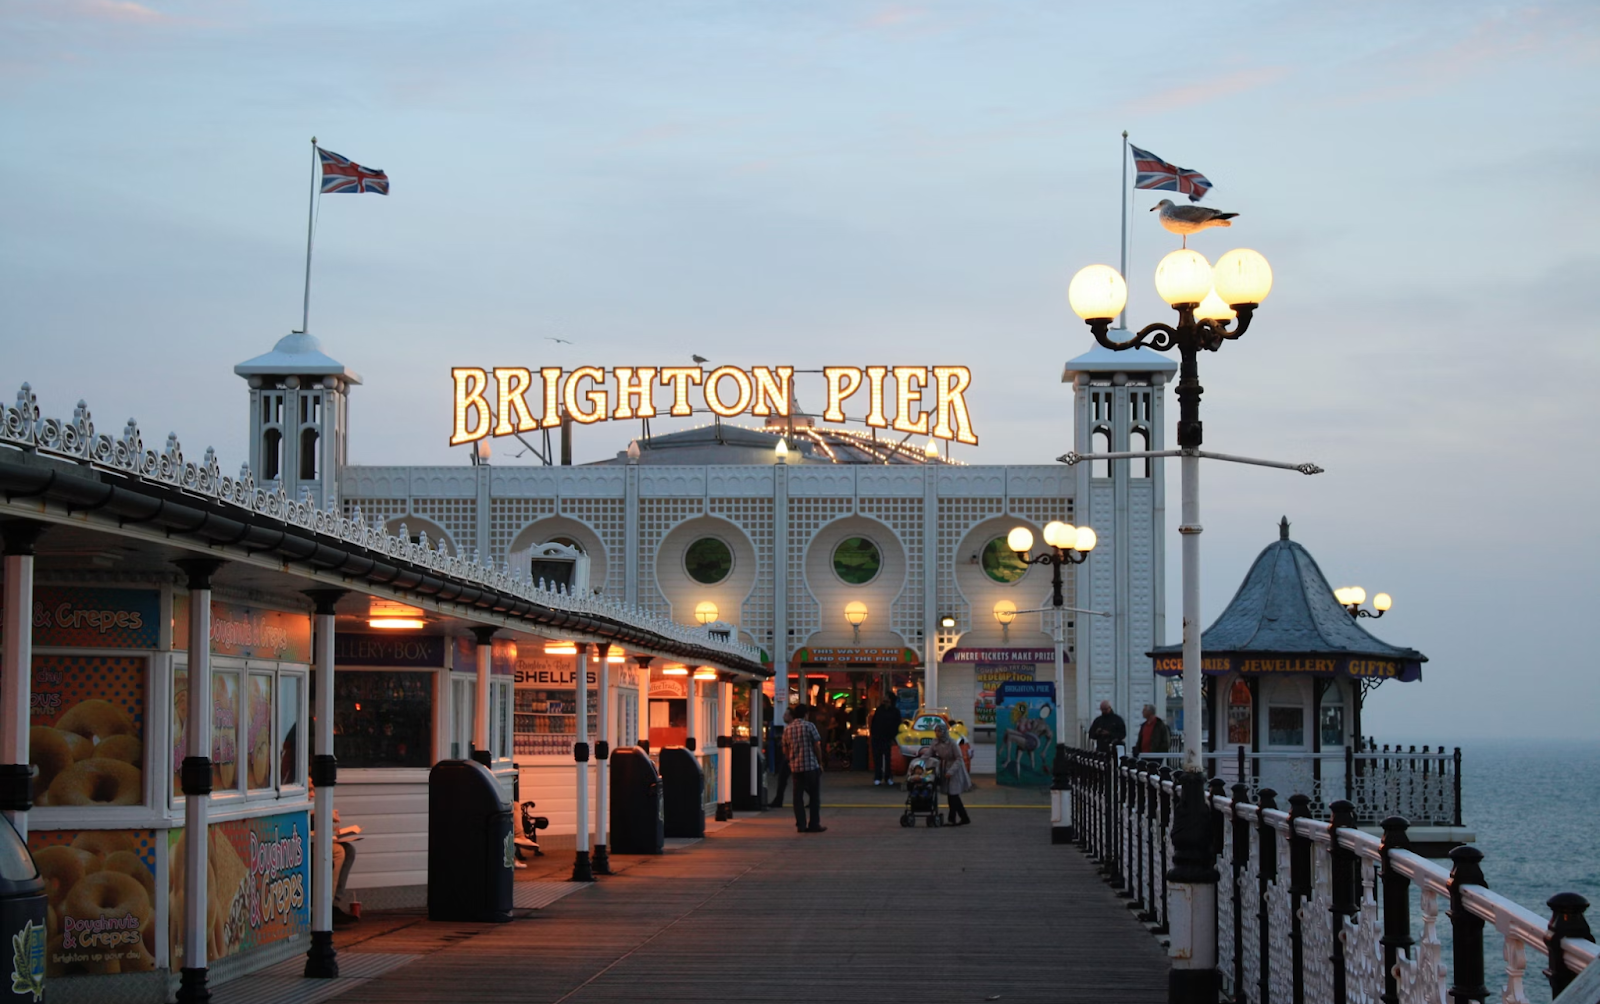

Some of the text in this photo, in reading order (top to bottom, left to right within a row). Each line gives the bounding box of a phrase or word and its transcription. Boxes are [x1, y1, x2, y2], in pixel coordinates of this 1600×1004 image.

[450, 365, 979, 447] BRIGHTON PIER
[55, 602, 143, 634] Crepes
[260, 617, 288, 655] Crepes
[953, 651, 1056, 662] WHERE TICKETS MAKE PRIZE
[976, 672, 1034, 682] REDEMPTION
[995, 665, 1008, 673] AND
[1240, 659, 1337, 672] JEWELLERY
[1348, 660, 1396, 676] GIFTS
[1004, 684, 1050, 693] BRIGHTON PIER
[250, 822, 304, 879] Doughnuts
[250, 871, 305, 929] & Crepes
[64, 912, 140, 934] Doughnuts
[62, 929, 77, 950] &
[78, 929, 141, 950] Crepes
[52, 951, 90, 965] Brighton
[91, 952, 103, 963] up
[104, 951, 124, 962] your
